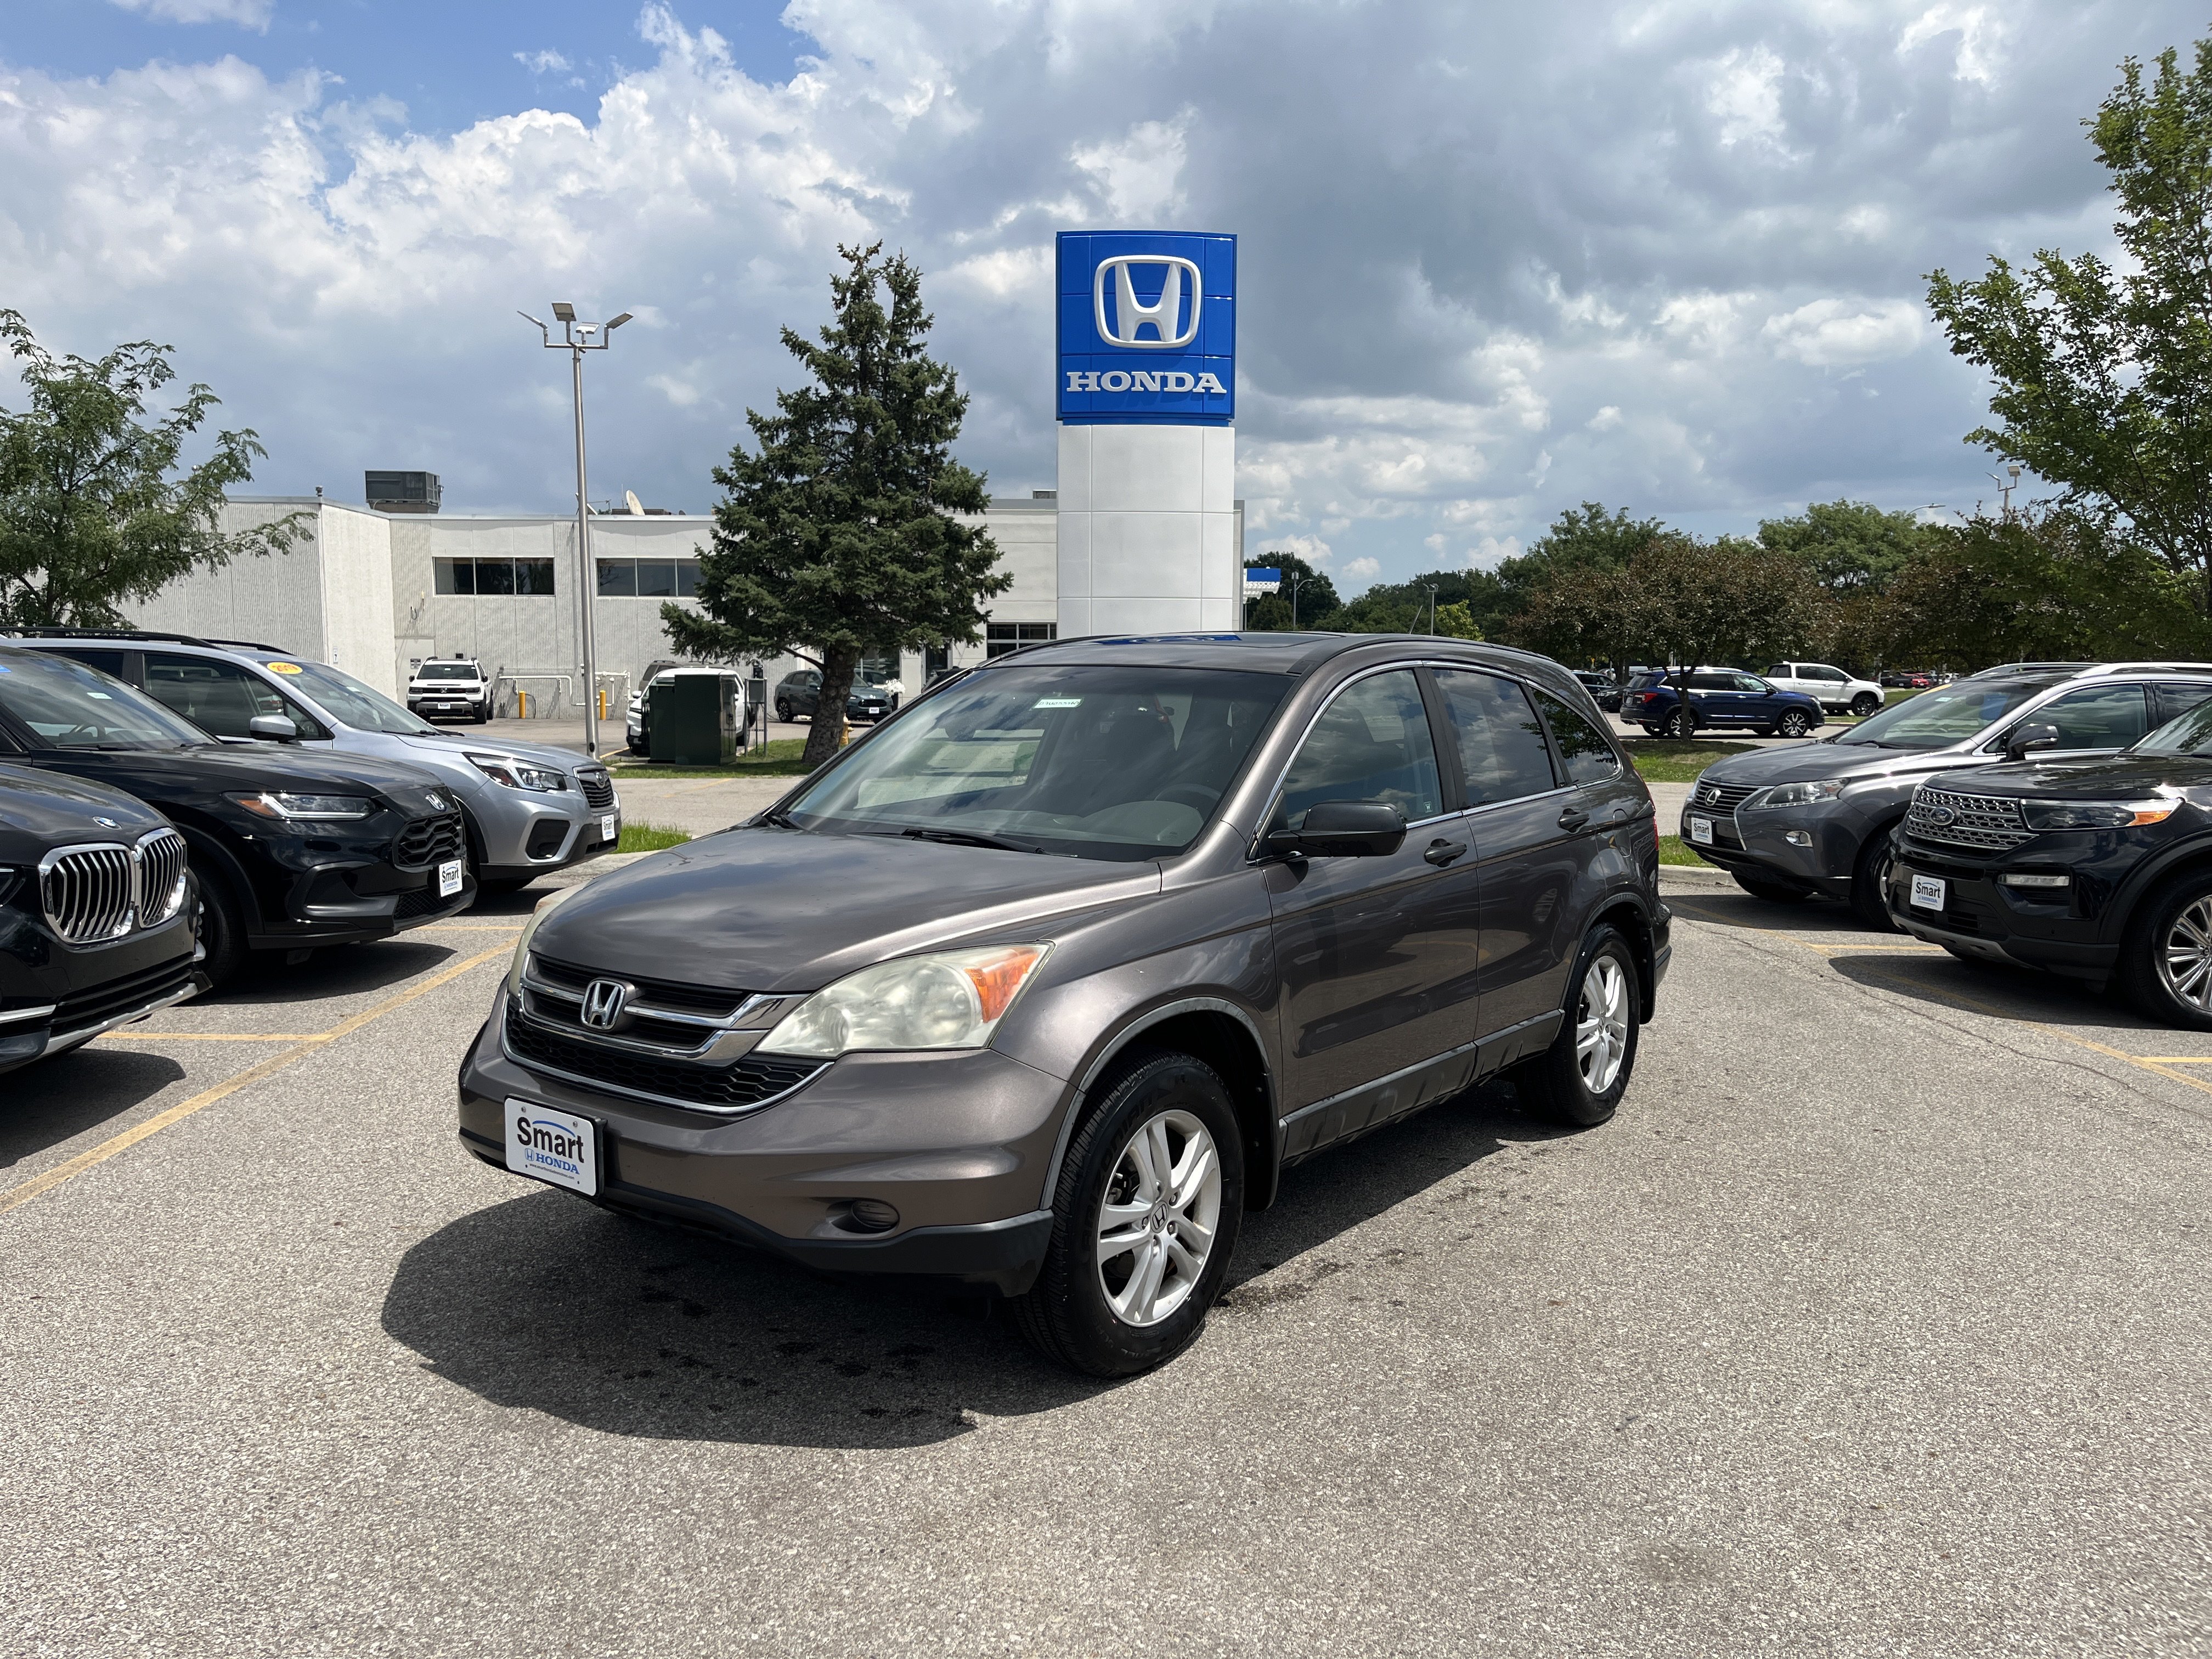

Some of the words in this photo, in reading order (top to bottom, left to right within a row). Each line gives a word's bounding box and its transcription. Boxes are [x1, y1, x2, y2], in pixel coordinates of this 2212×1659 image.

[1066, 371, 1227, 394] HONDA
[1694, 822, 1709, 834] Smart
[442, 867, 459, 883] Smart
[1916, 882, 1940, 899] Smart
[517, 1116, 585, 1164] Smart
[535, 1153, 580, 1175] HONDA
